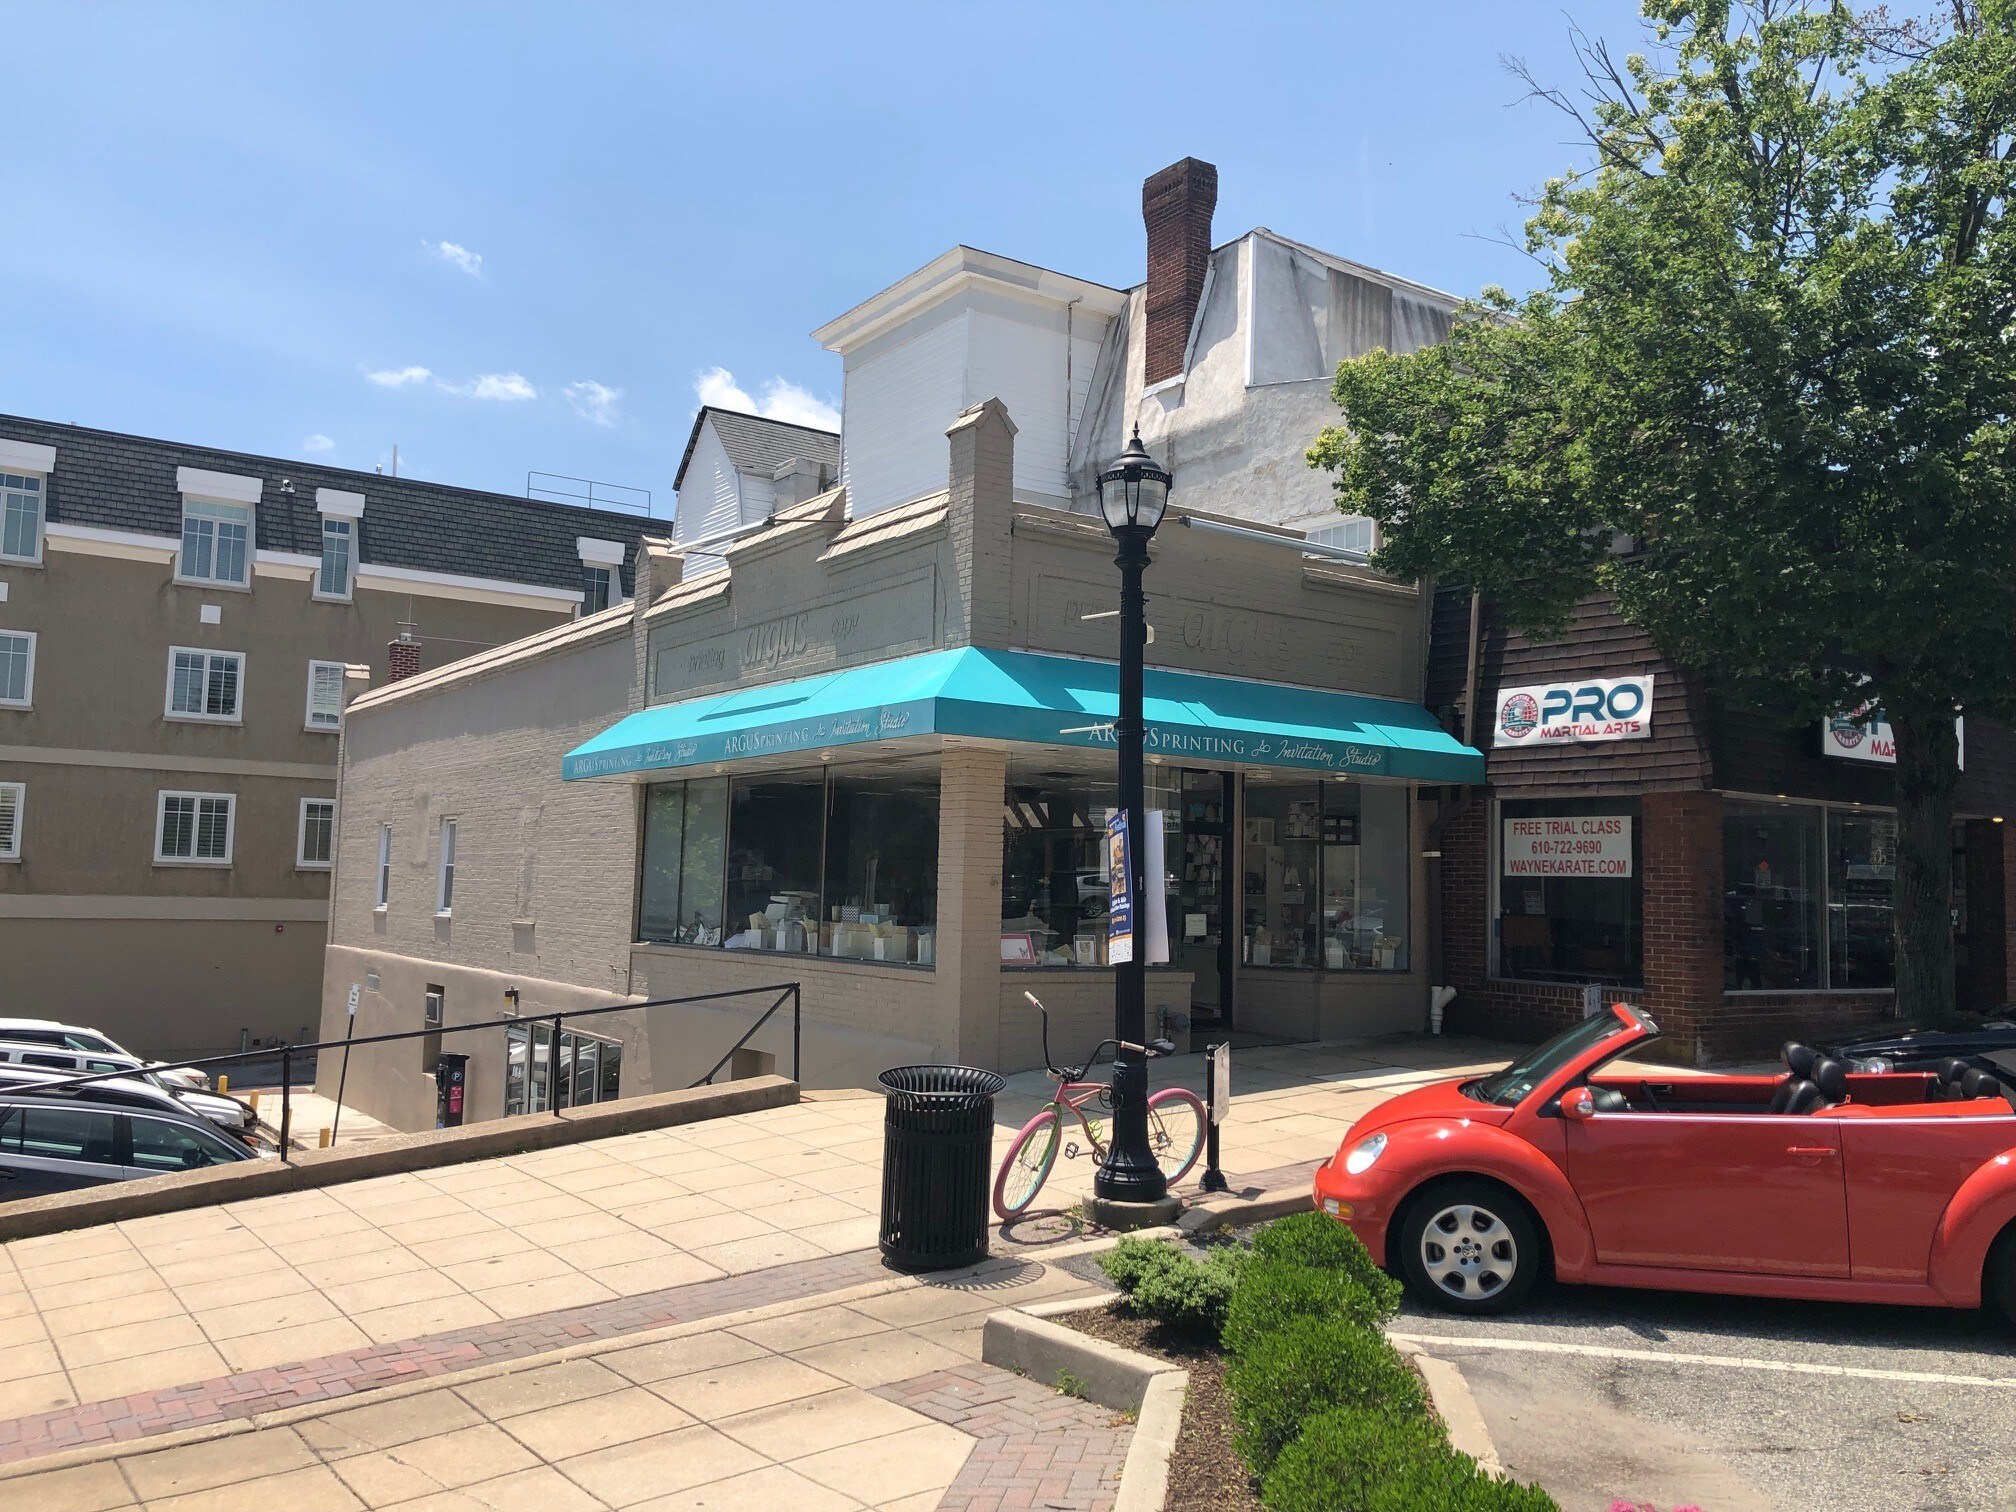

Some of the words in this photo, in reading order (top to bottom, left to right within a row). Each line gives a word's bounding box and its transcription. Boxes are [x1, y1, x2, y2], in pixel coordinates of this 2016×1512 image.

[746, 612, 809, 670] argus
[1541, 683, 1644, 725] PRO
[829, 714, 872, 738] Invitation
[875, 711, 909, 735] Studio
[1540, 725, 1598, 738] MARTIAL
[1603, 721, 1641, 734] ARTS
[1276, 738, 1335, 766] Invitation
[1339, 745, 1382, 768] Studio
[1513, 821, 1542, 835] FREE
[1545, 821, 1578, 835] TRIAL
[1581, 820, 1622, 834] CLASS
[1532, 840, 1602, 854] 610-722-9690
[1510, 860, 1627, 874] WAYNEKARATE.COM
